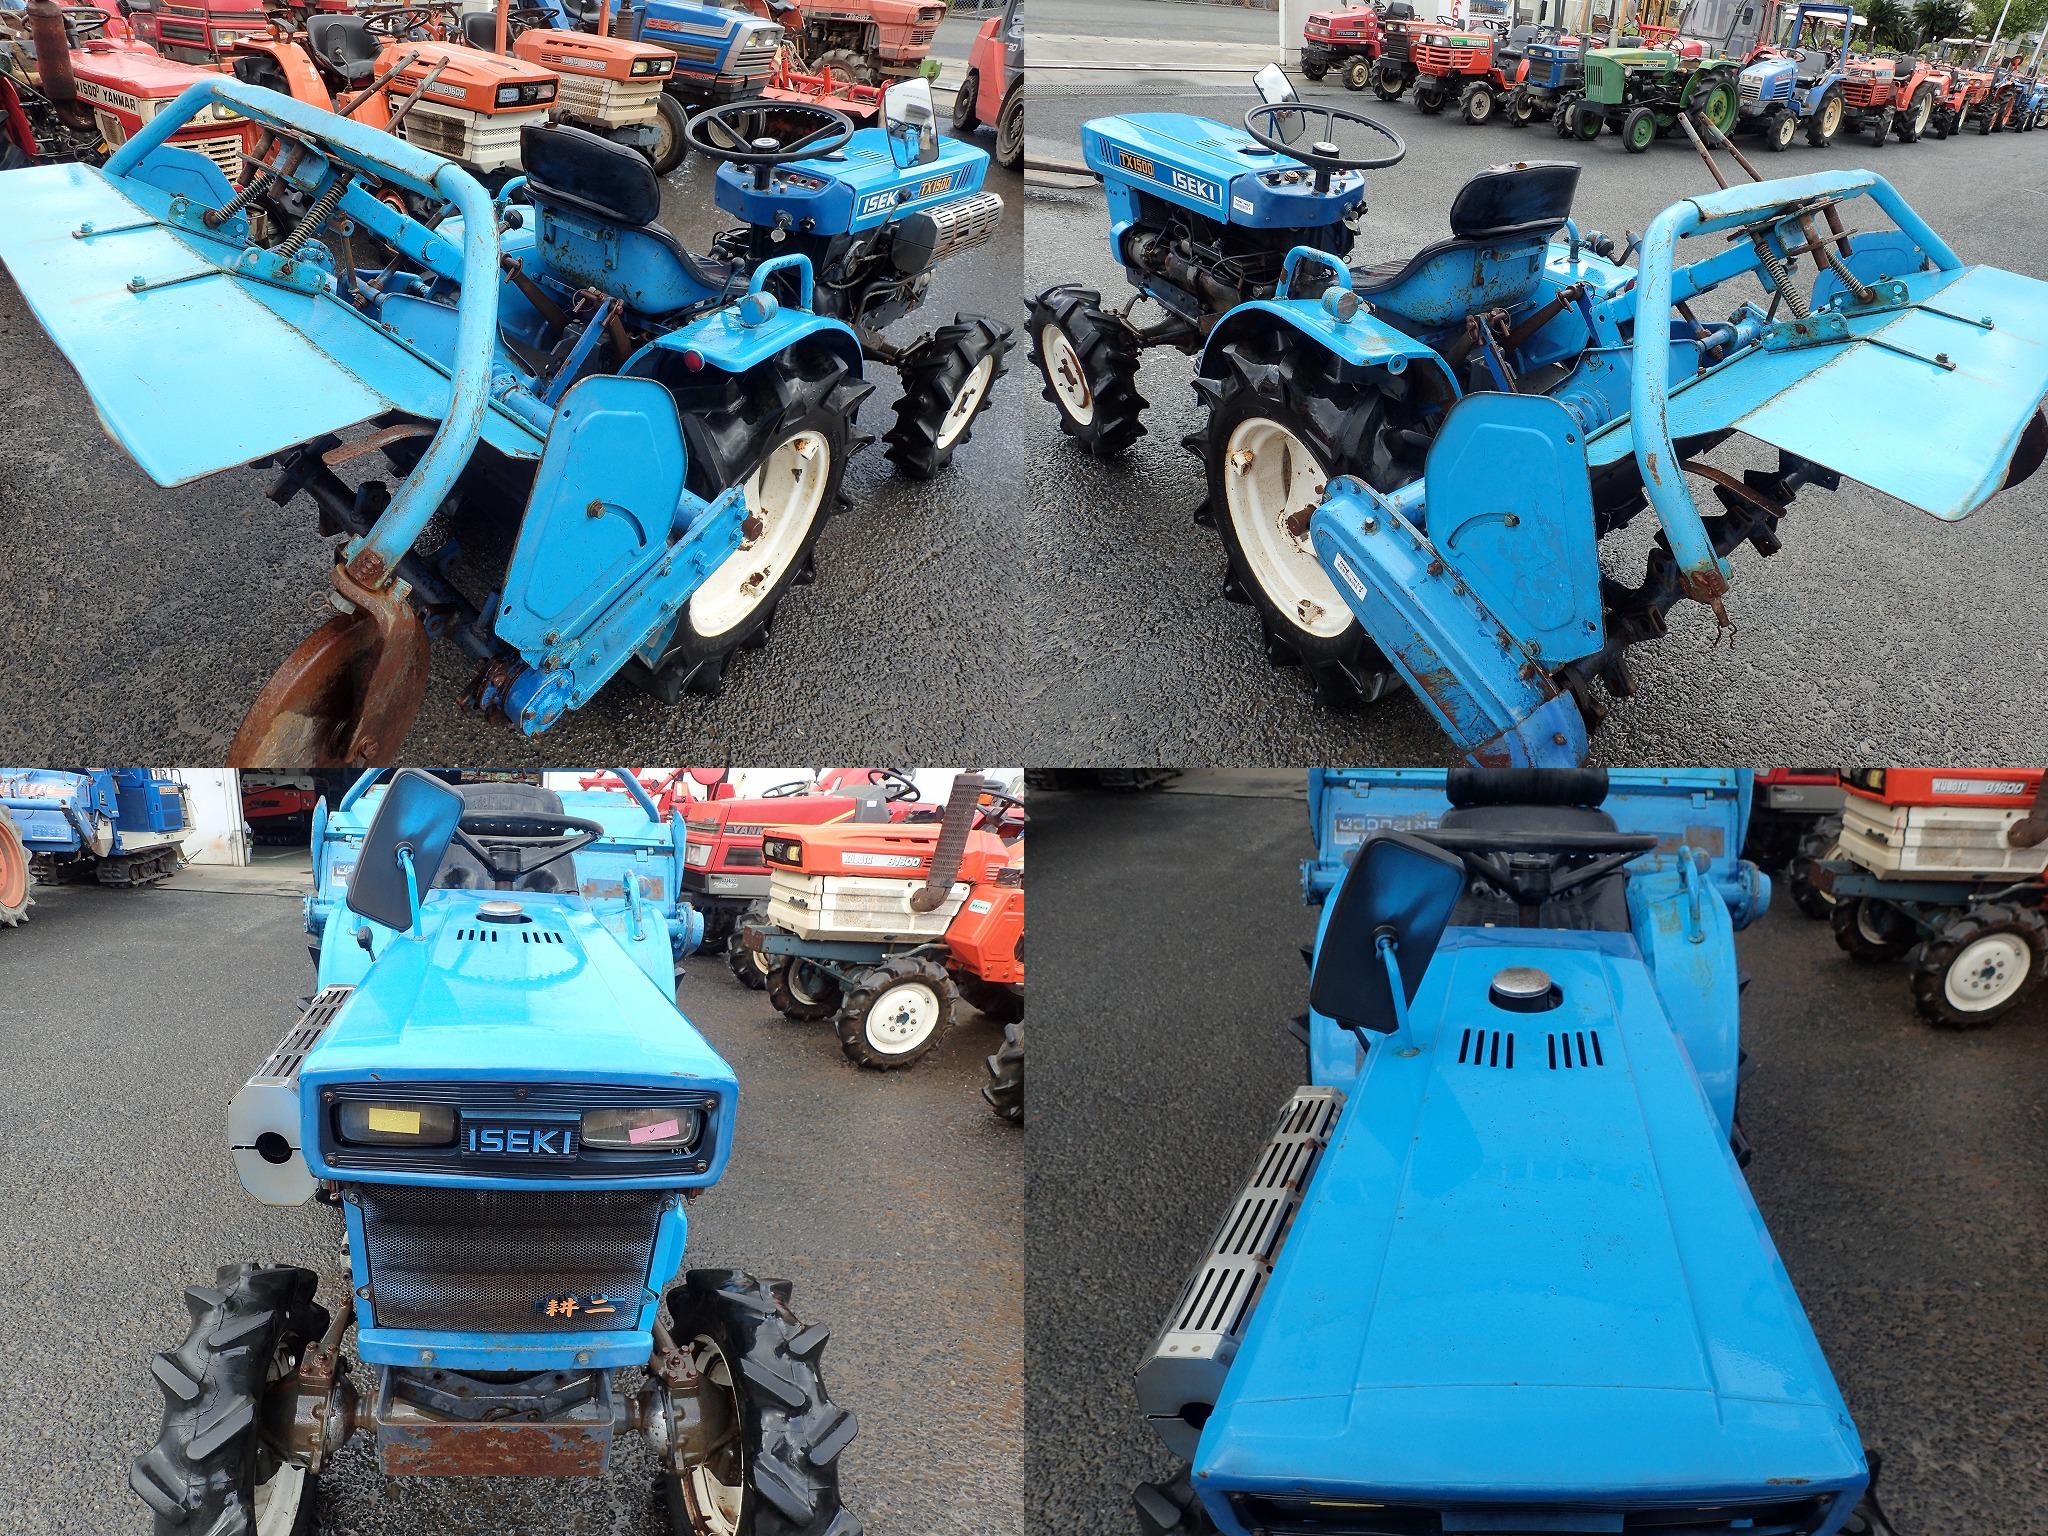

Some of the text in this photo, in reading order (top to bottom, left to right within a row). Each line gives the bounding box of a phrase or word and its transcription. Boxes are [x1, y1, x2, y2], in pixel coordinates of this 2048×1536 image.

[103, 89, 136, 111] YANMAR
[1119, 151, 1215, 201] TX1500 ISEKI
[863, 175, 952, 213] ISEK TX1500
[1935, 780, 1969, 793] KUBOTA
[844, 853, 922, 868] KUBOTA B1600
[469, 1128, 572, 1154] ISEKI
[545, 1296, 617, 1318] 耕二
